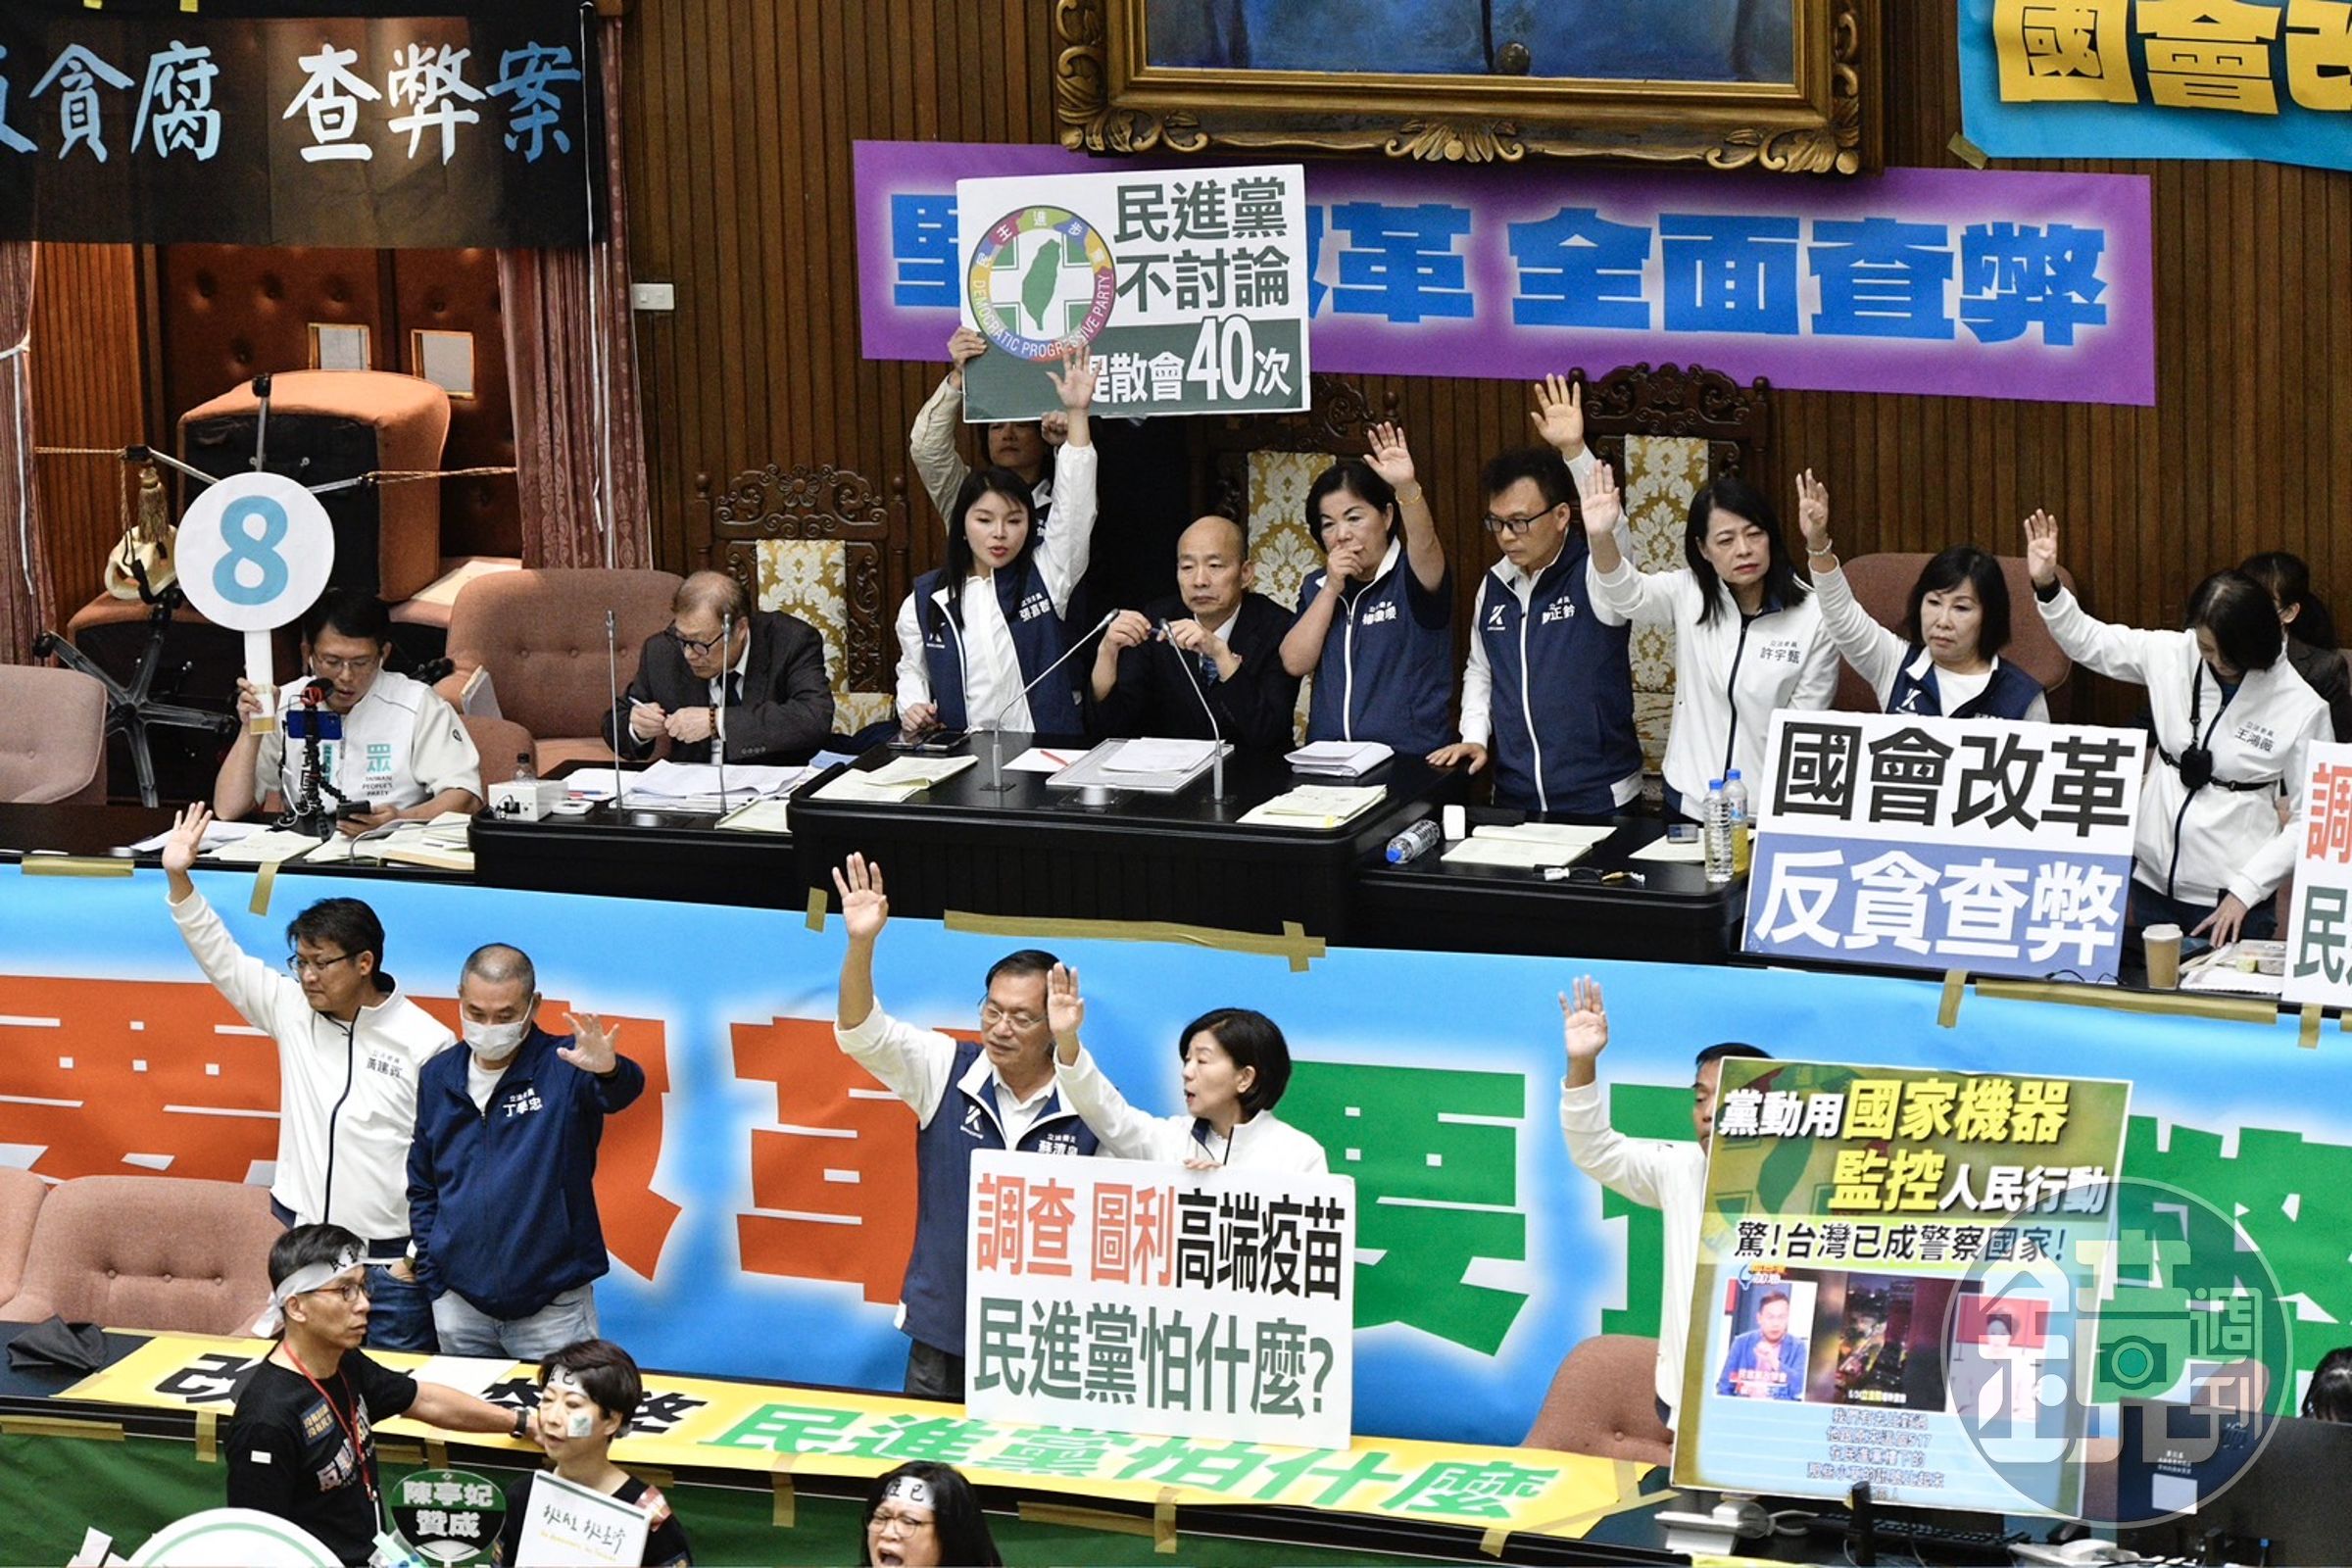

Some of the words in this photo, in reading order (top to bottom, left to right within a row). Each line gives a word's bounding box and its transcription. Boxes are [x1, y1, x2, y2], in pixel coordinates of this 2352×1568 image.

[282, 40, 582, 165] 查弊案
[1113, 176, 1288, 244] 民進黨
[973, 280, 1021, 353] DEMOCRATIC
[1096, 274, 1111, 318] PARTY
[1115, 245, 1290, 314] 不討論
[213, 495, 289, 607] 8
[1771, 720, 2135, 838] 國會改革
[1753, 850, 2123, 966] 反貪查弊
[1718, 1078, 2071, 1144] 黨動用國家機器
[1828, 1149, 2112, 1213] 監控人民行動
[972, 1297, 1335, 1421] 民進黨怕什麼?
[403, 1480, 493, 1508] 陳亭妃
